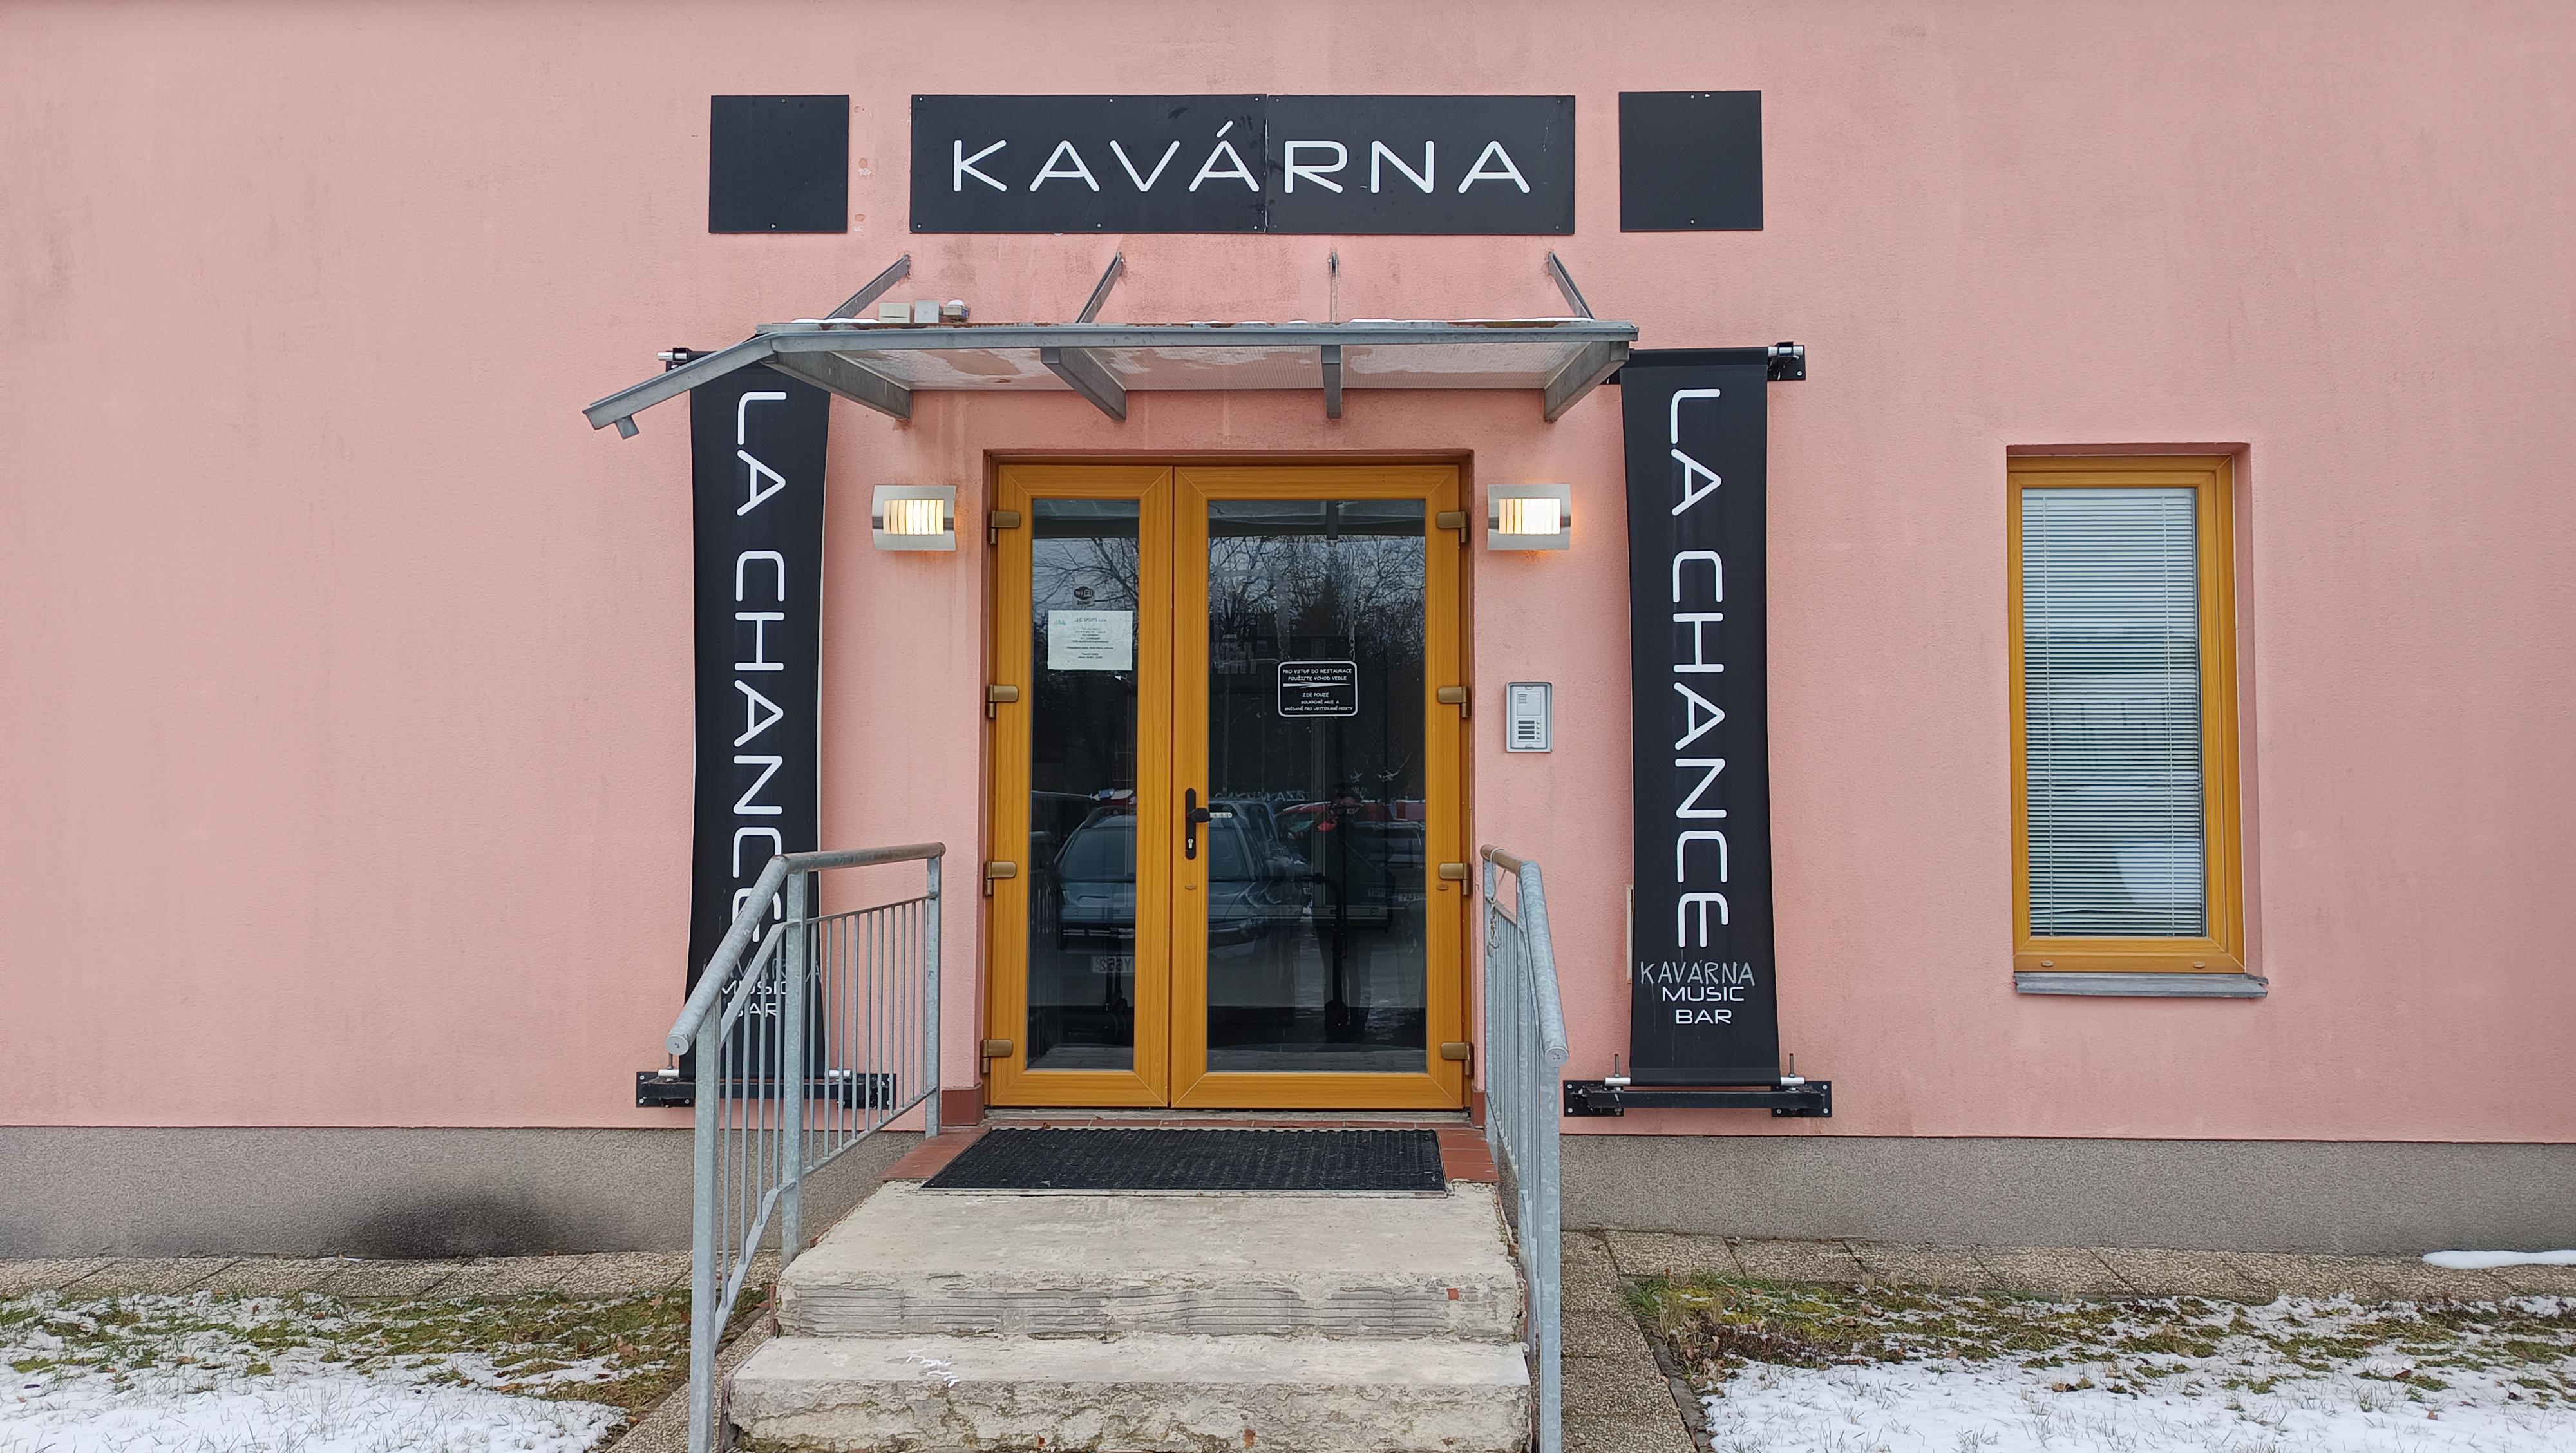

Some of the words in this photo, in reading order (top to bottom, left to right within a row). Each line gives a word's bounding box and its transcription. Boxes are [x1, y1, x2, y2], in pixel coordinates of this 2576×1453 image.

[953, 120, 1531, 194] KAVÁRNA
[736, 392, 787, 516] LA
[1671, 388, 1722, 516] LA
[1672, 551, 1729, 948] CHANCE
[1640, 959, 1756, 987] KAVÁRNA
[1662, 986, 1745, 1002] MUSIC
[1676, 1009, 1732, 1025] BAR
